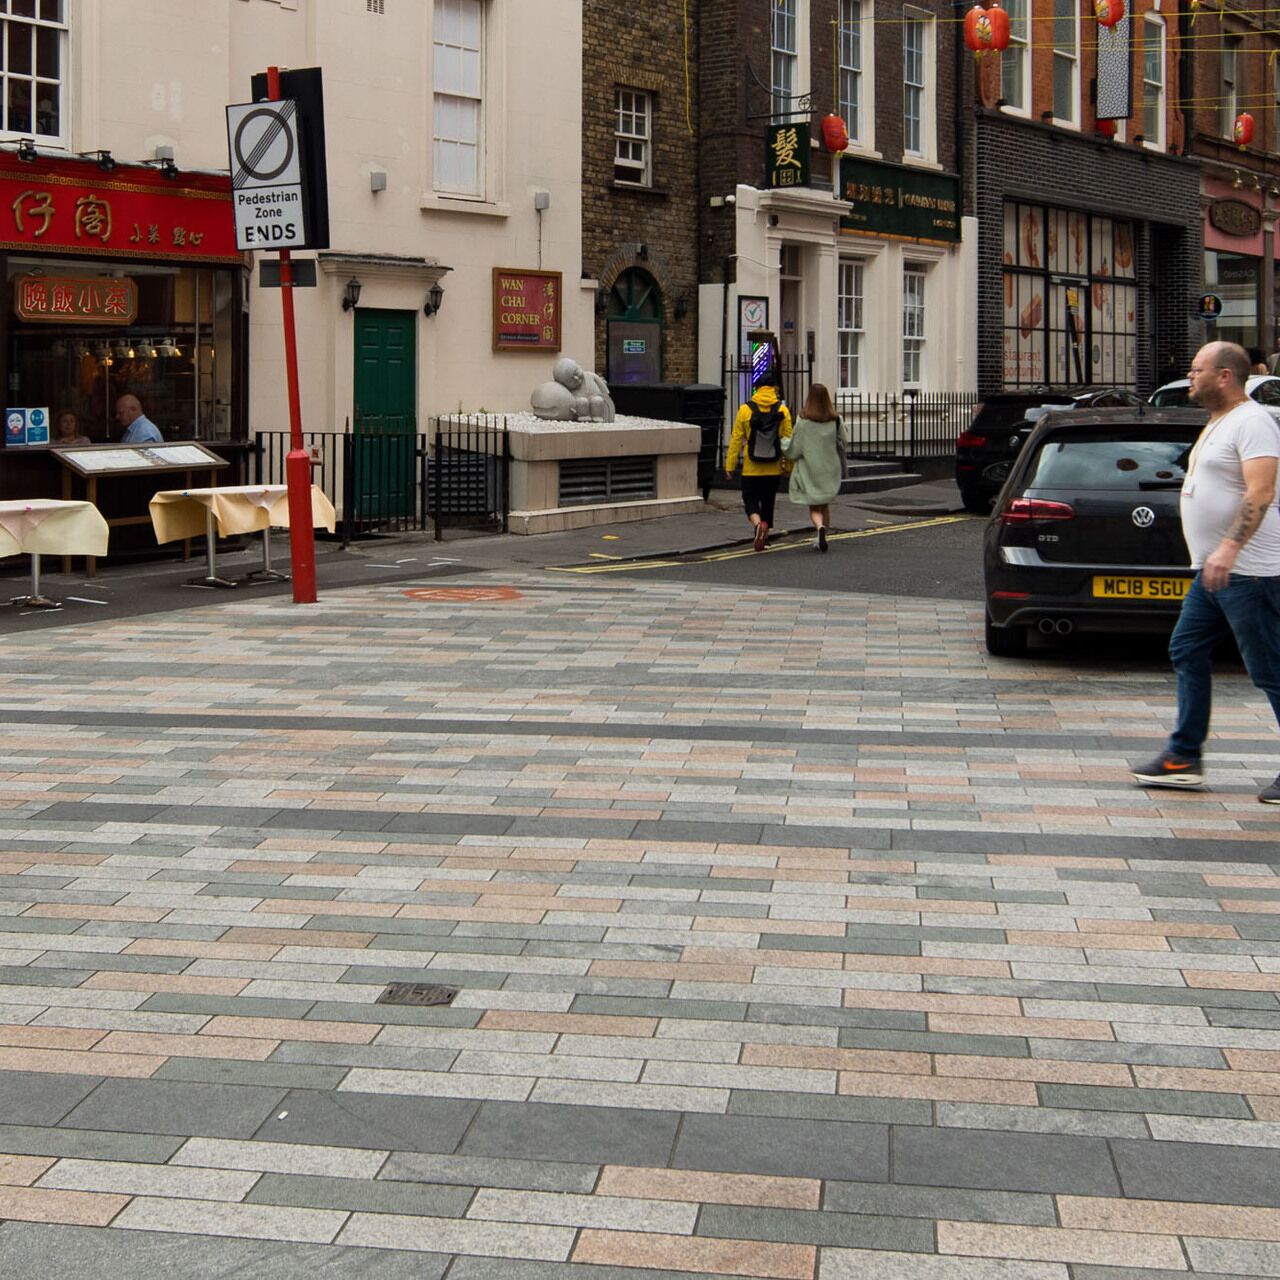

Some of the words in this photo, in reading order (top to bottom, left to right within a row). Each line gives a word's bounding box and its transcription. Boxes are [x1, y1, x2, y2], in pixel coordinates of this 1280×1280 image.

[238, 191, 298, 205] Pedestrian
[255, 207, 282, 218] Zone
[245, 223, 296, 242] ENDS
[501, 278, 524, 290] WAN
[24, 282, 129, 314] 晚飯小菜
[501, 295, 526, 308] CHAI
[501, 312, 540, 325] CORNER
[1038, 534, 1059, 542] GTD
[1104, 578, 1143, 595] MC18
[1149, 579, 1184, 596] SGU
